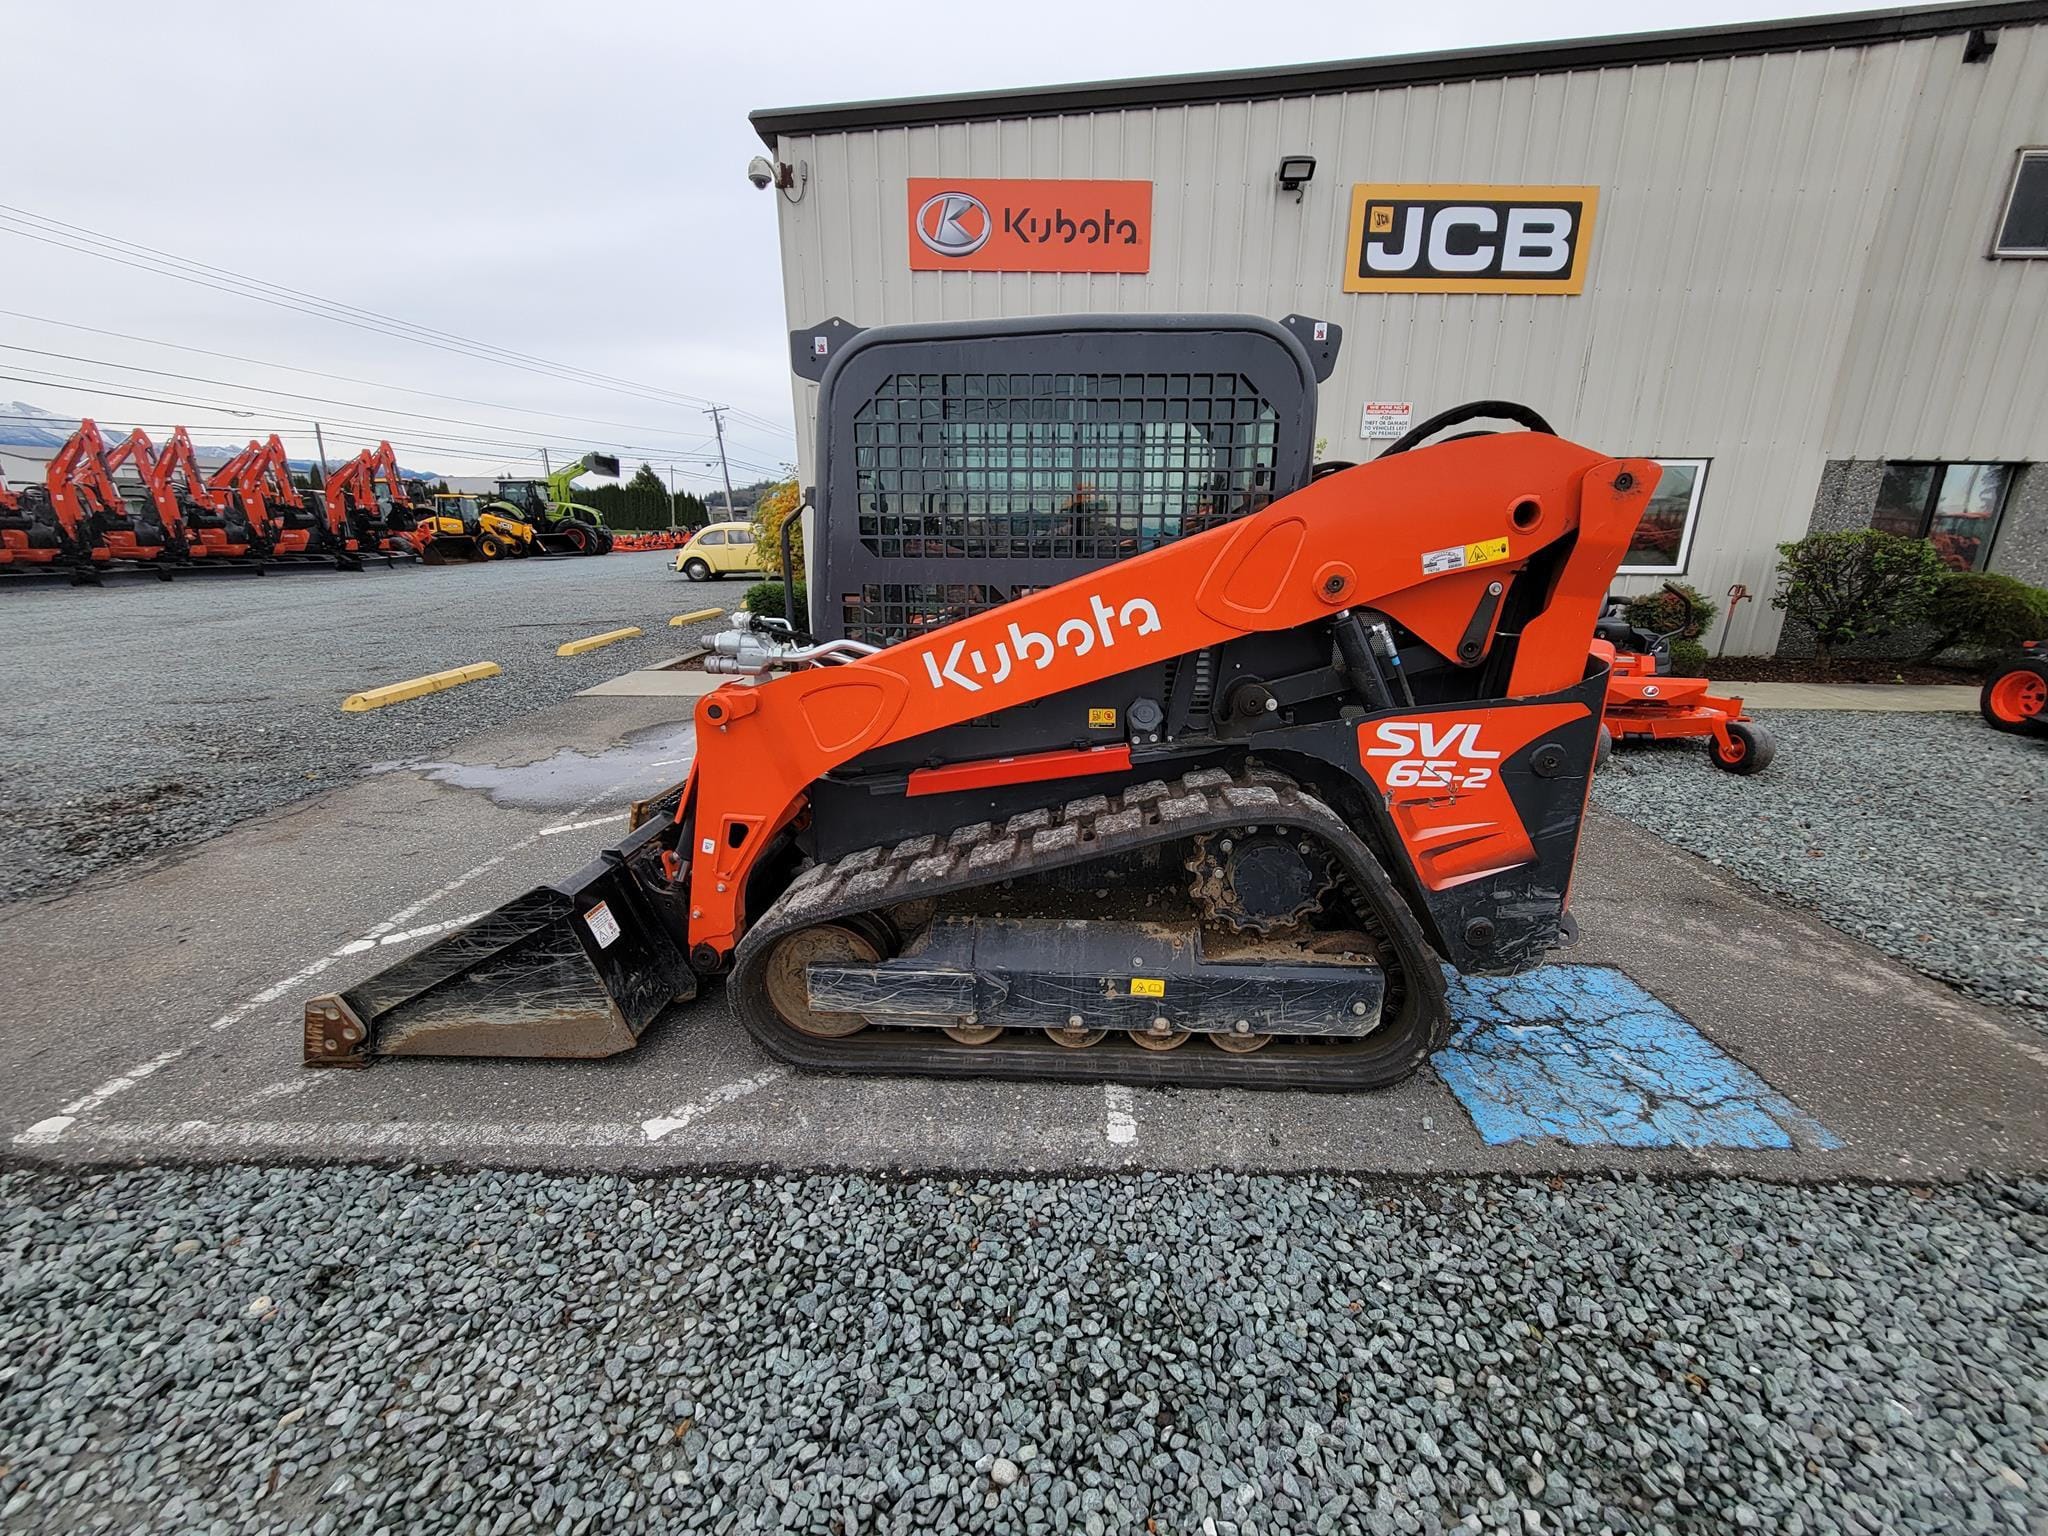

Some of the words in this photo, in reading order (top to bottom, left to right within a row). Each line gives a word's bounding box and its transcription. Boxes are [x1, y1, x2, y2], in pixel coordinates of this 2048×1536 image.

[1004, 207, 1137, 244] Kubota
[1366, 206, 1572, 272] JCB
[921, 594, 1162, 692] Kubota
[1366, 722, 1501, 759] SVL
[1385, 760, 1492, 788] 65-2
